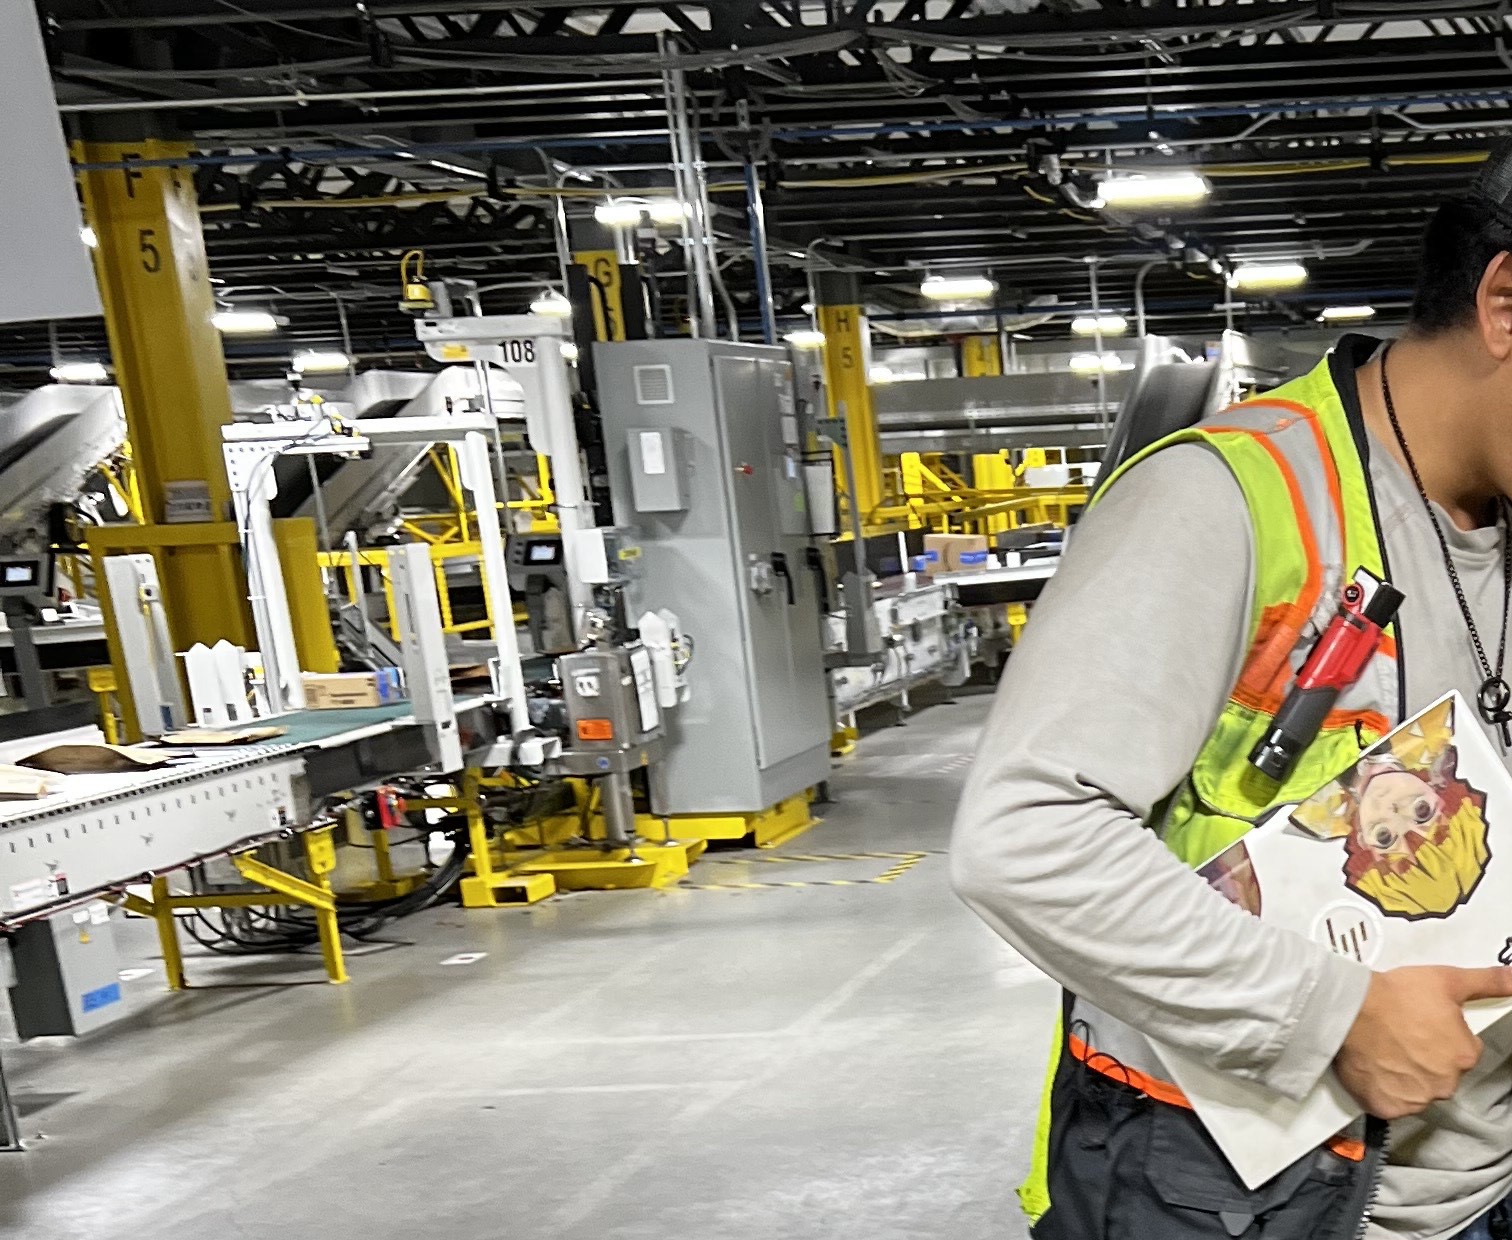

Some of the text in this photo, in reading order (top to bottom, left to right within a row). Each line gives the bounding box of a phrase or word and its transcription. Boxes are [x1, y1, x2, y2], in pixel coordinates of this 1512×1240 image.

[122, 153, 143, 199] F
[138, 228, 161, 273] 5
[594, 257, 613, 288] G
[837, 309, 851, 332] H
[499, 339, 535, 363] 108
[841, 346, 854, 369] 5
